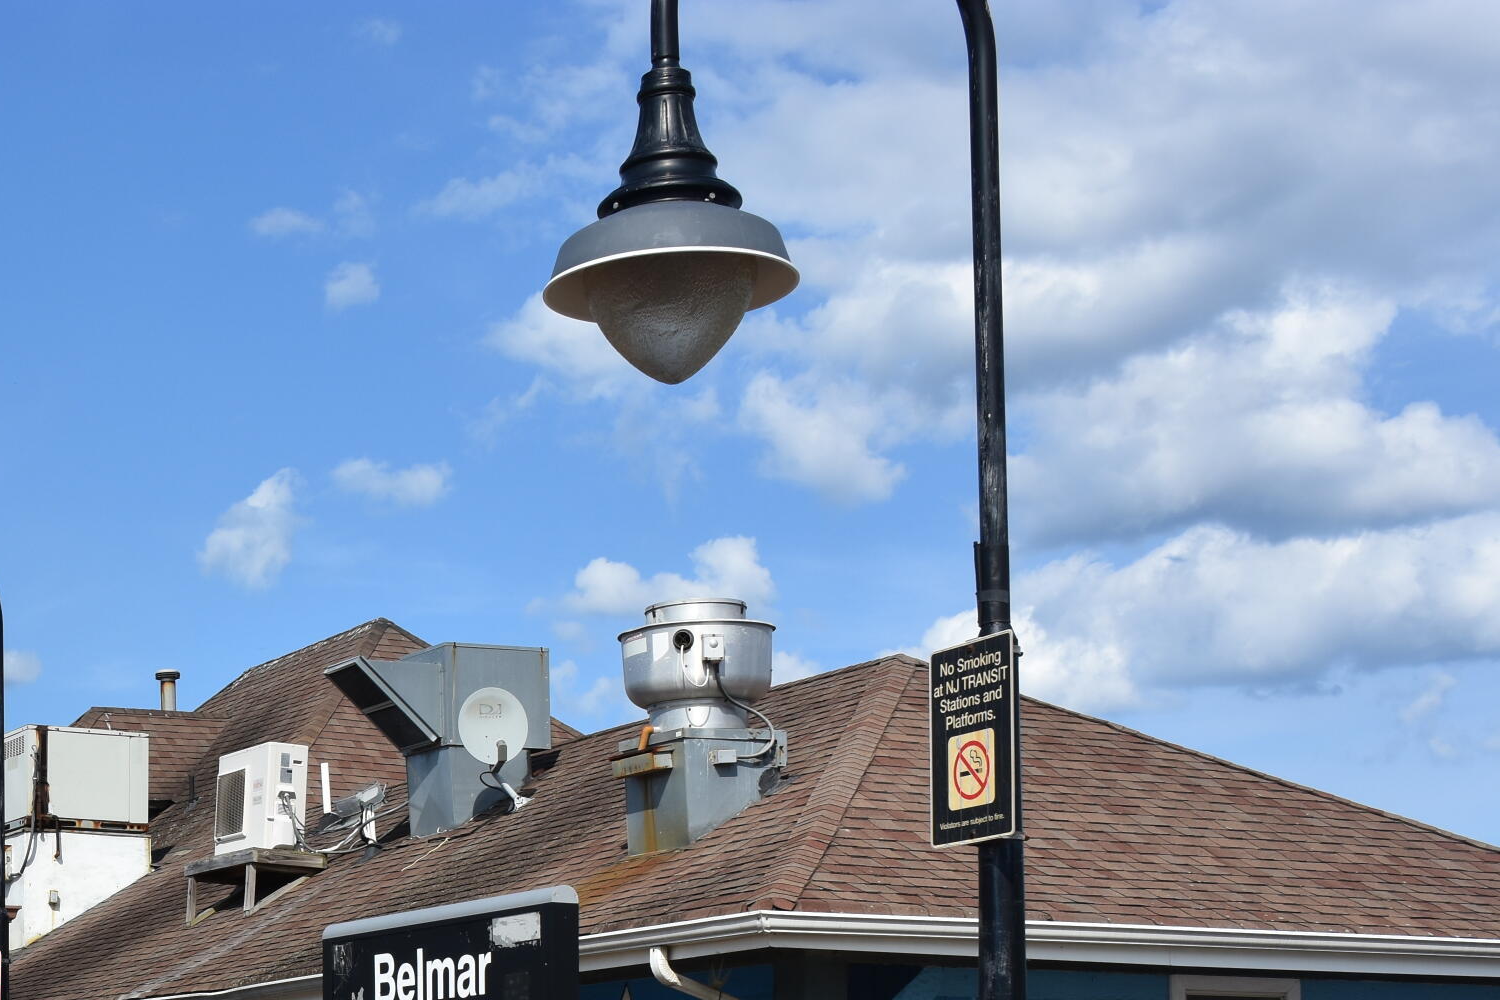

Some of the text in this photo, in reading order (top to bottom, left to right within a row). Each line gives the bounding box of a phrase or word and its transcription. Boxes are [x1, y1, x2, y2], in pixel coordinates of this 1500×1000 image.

[940, 651, 1002, 678] No Smoking
[933, 665, 1009, 698] at NJ TRANSIT
[940, 684, 1003, 714] Stations and
[945, 709, 997, 731] Platforms.
[939, 820, 961, 831] Violators
[970, 815, 988, 826] subject
